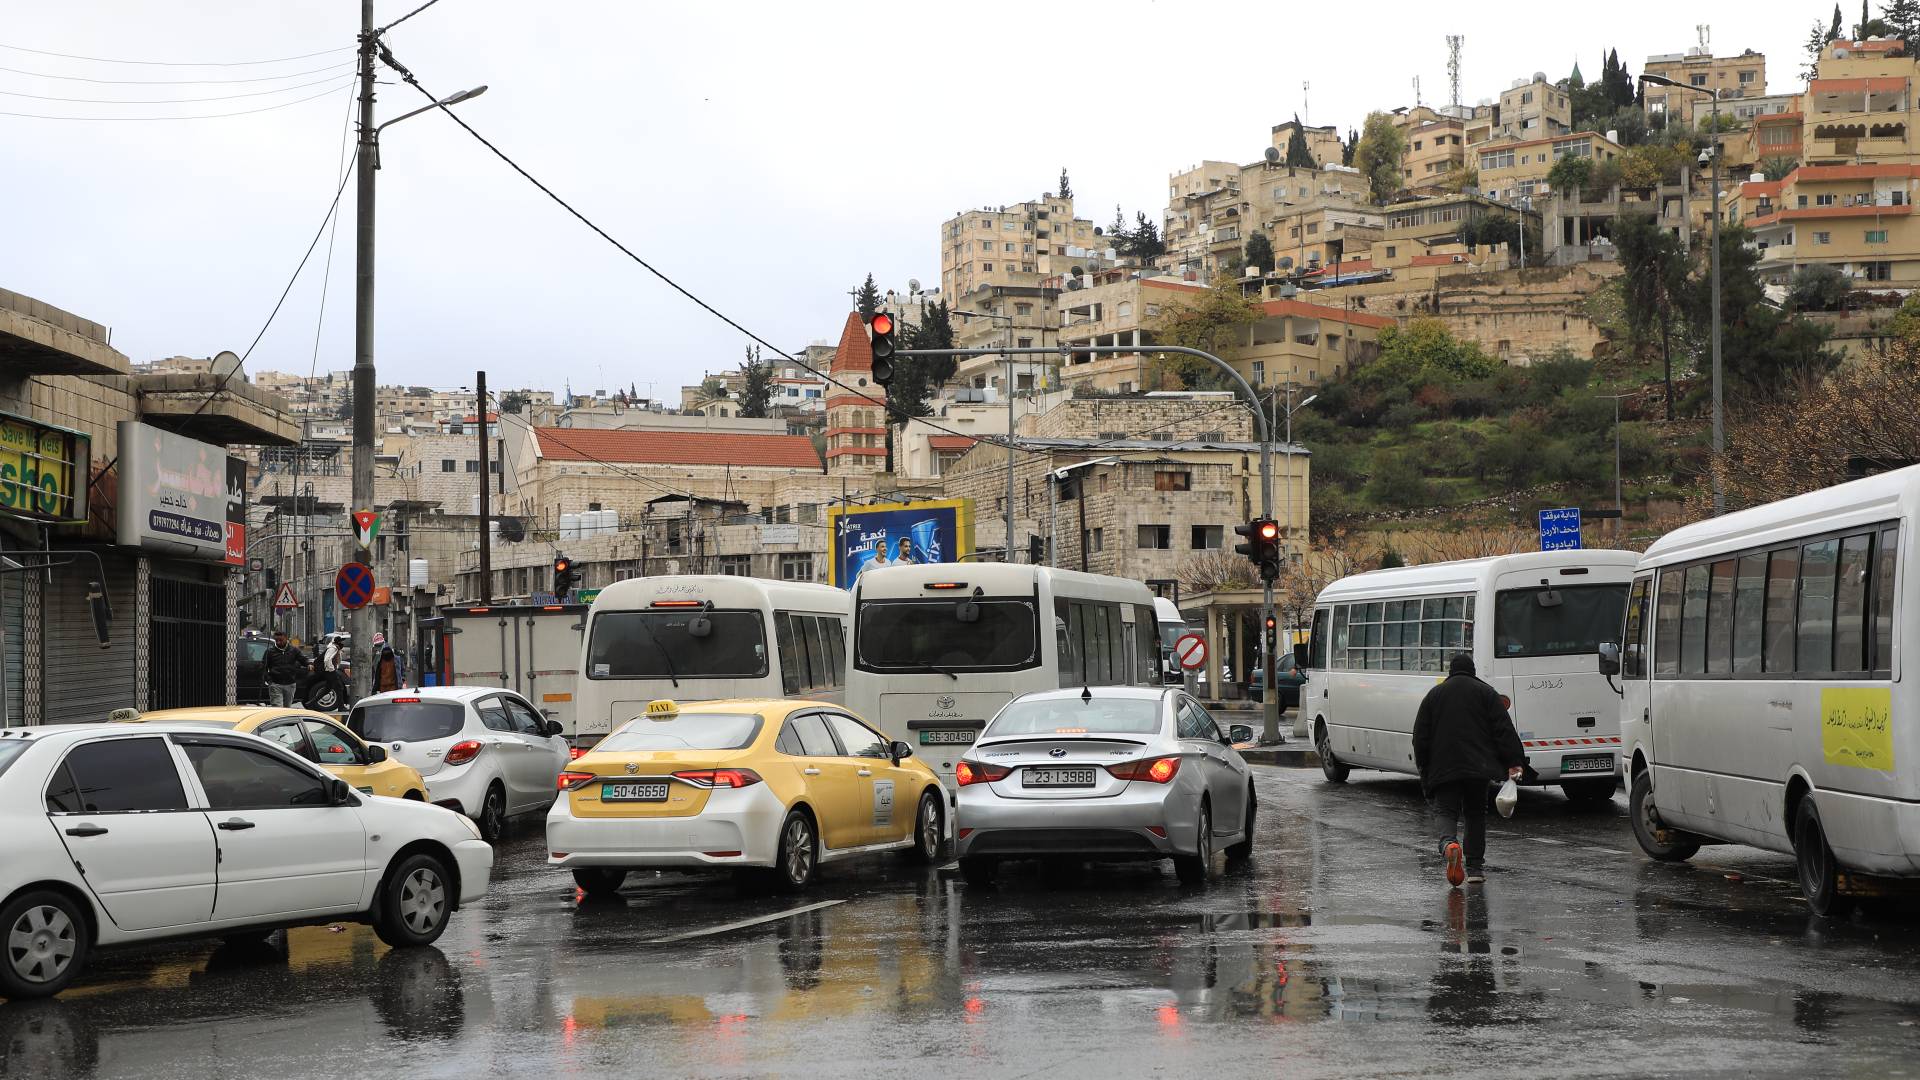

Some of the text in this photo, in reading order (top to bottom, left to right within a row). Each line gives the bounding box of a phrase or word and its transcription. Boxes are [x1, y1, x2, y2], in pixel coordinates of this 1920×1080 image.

[1542, 510, 1578, 522] بداية موقف
[1541, 524, 1579, 537] متحف الأردن
[847, 541, 873, 557] النصر
[650, 703, 670, 713] TAXI
[613, 785, 666, 798] 50-46658
